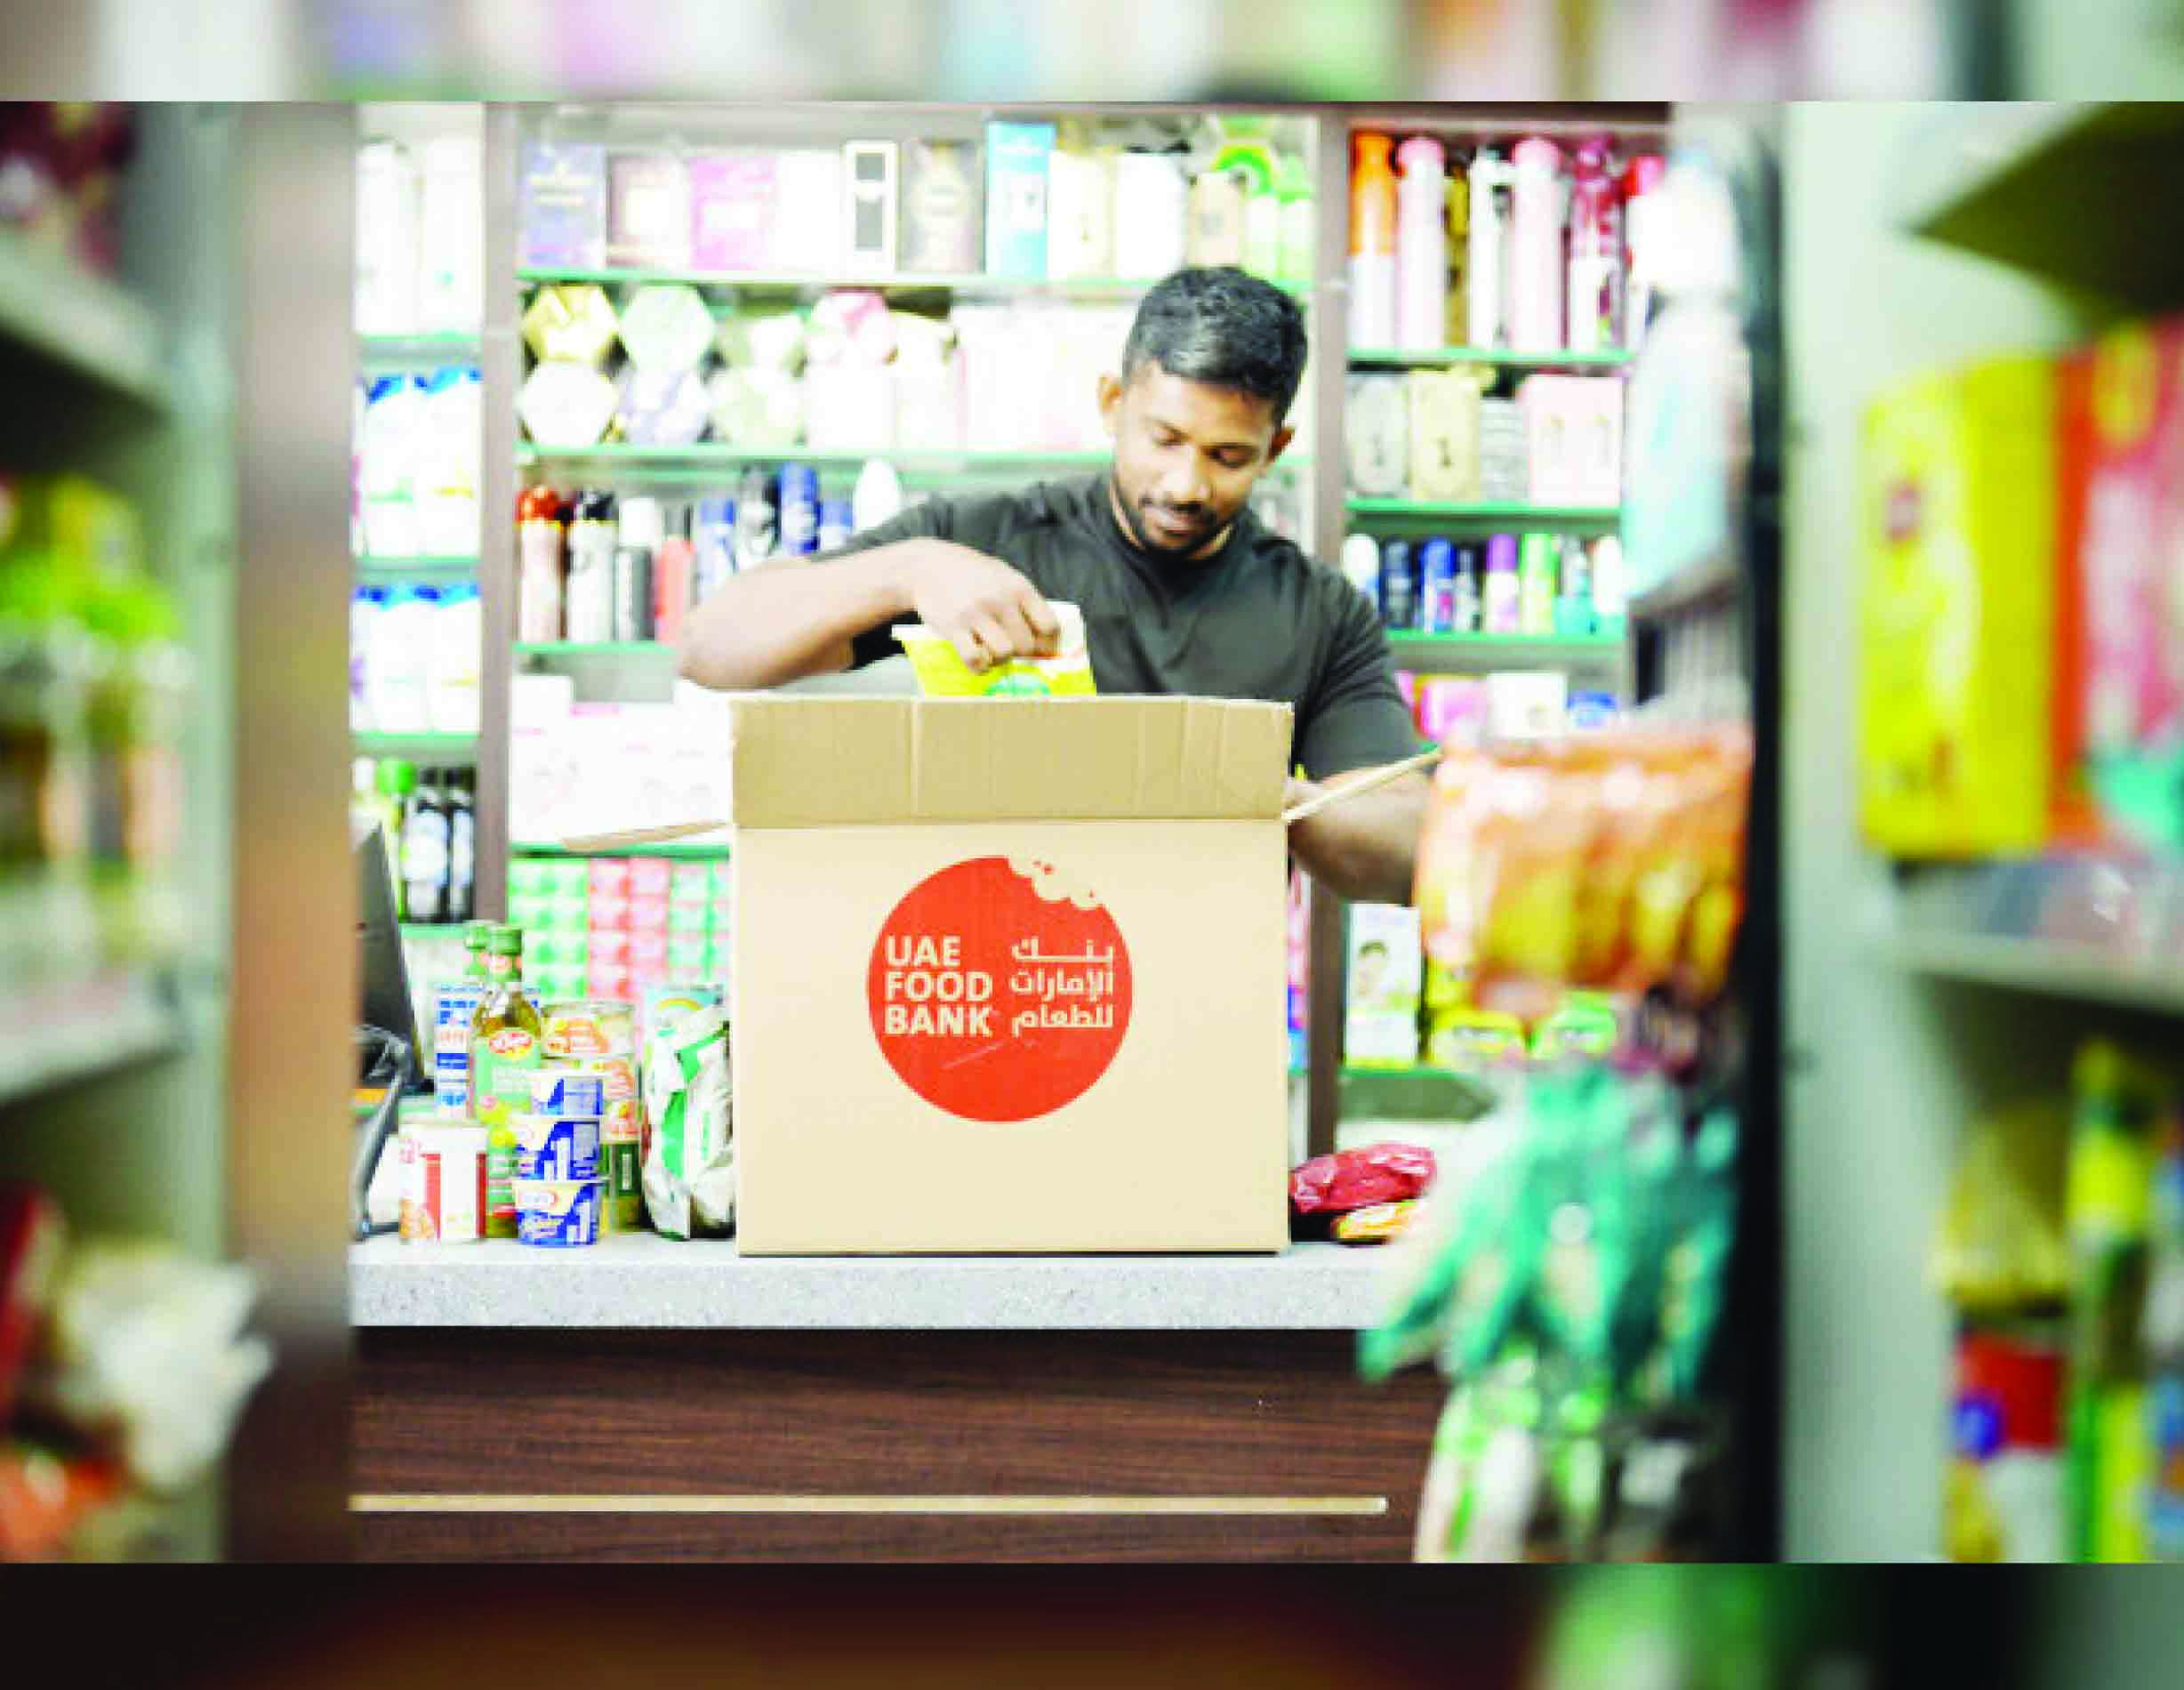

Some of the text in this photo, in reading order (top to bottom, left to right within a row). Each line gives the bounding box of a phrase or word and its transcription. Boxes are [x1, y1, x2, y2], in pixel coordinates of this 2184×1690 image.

[886, 935, 961, 968] UAE
[886, 970, 993, 1002] FOOD
[1010, 967, 1113, 1002] الإمارات
[886, 1004, 993, 1036] BANK
[1011, 1003, 1113, 1038] للطعام
